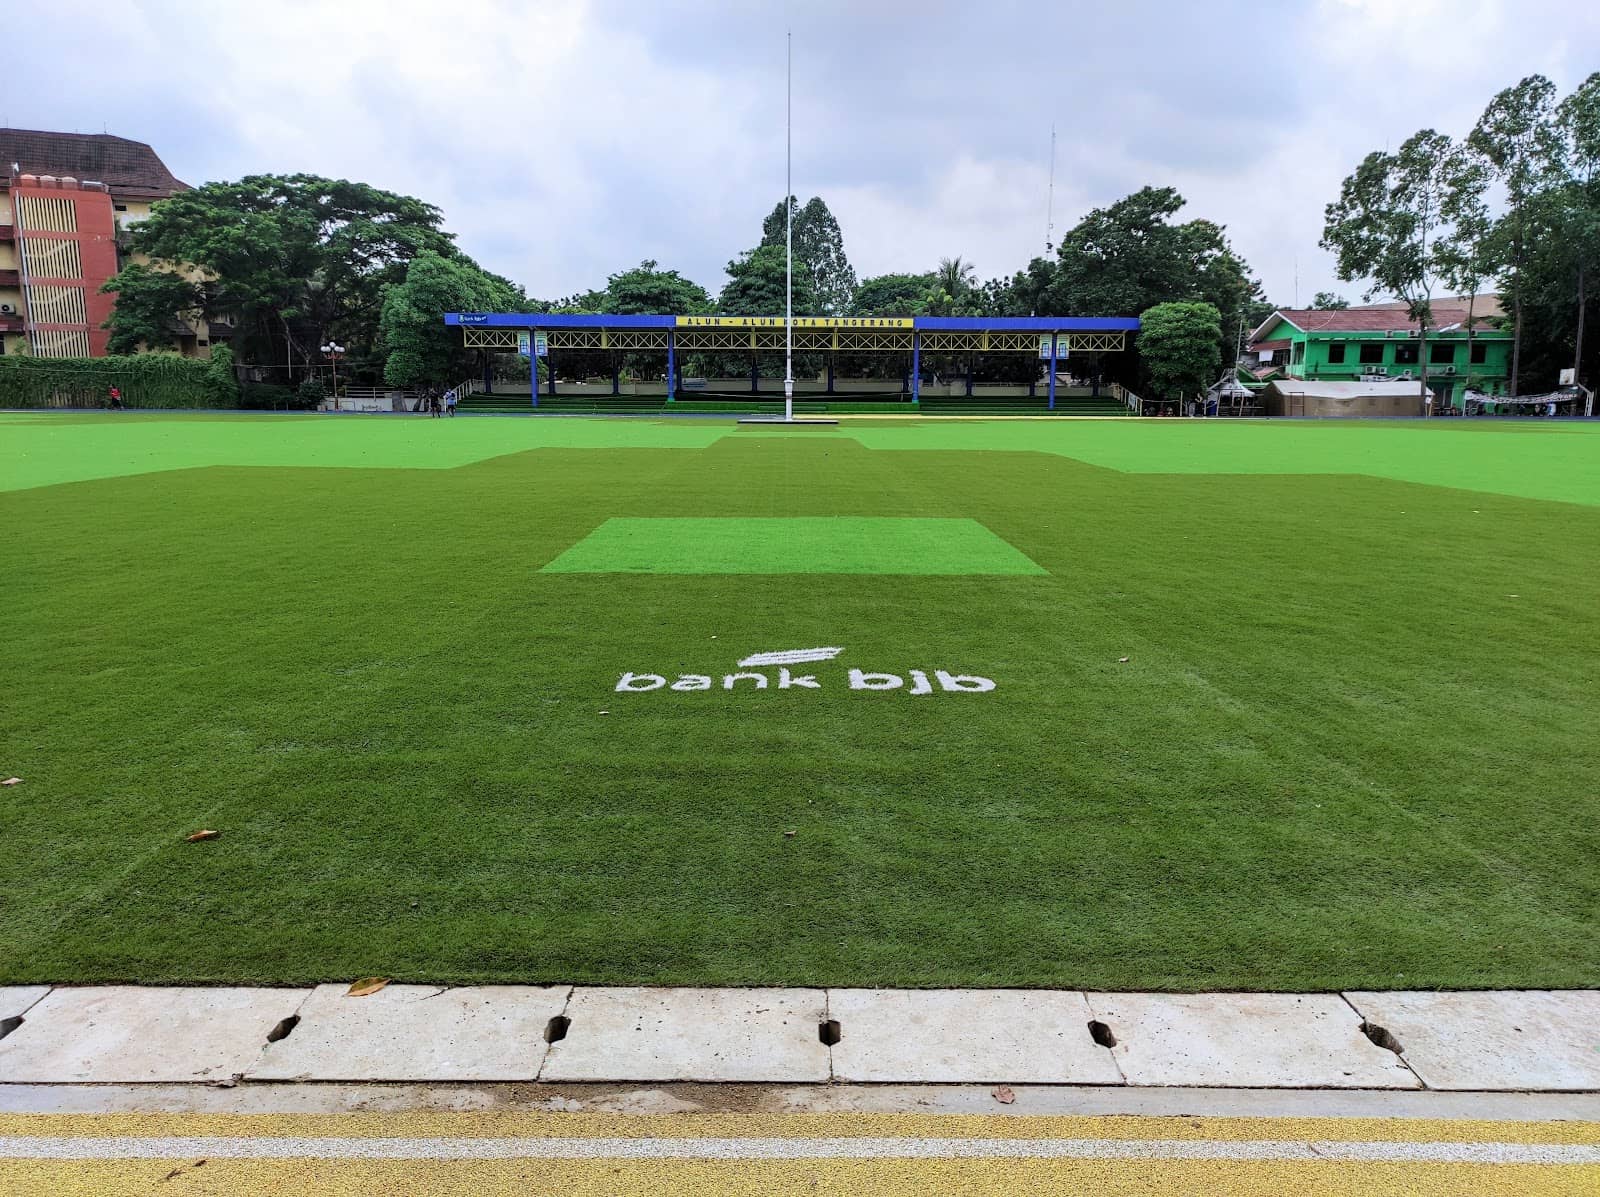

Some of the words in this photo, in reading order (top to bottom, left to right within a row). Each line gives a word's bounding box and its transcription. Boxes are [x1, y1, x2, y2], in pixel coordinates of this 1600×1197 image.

[687, 317, 720, 326] ALUN
[742, 318, 775, 326] ALUN
[824, 318, 903, 327] TANGERANG
[614, 667, 821, 692] bank
[848, 669, 997, 695] bjb
